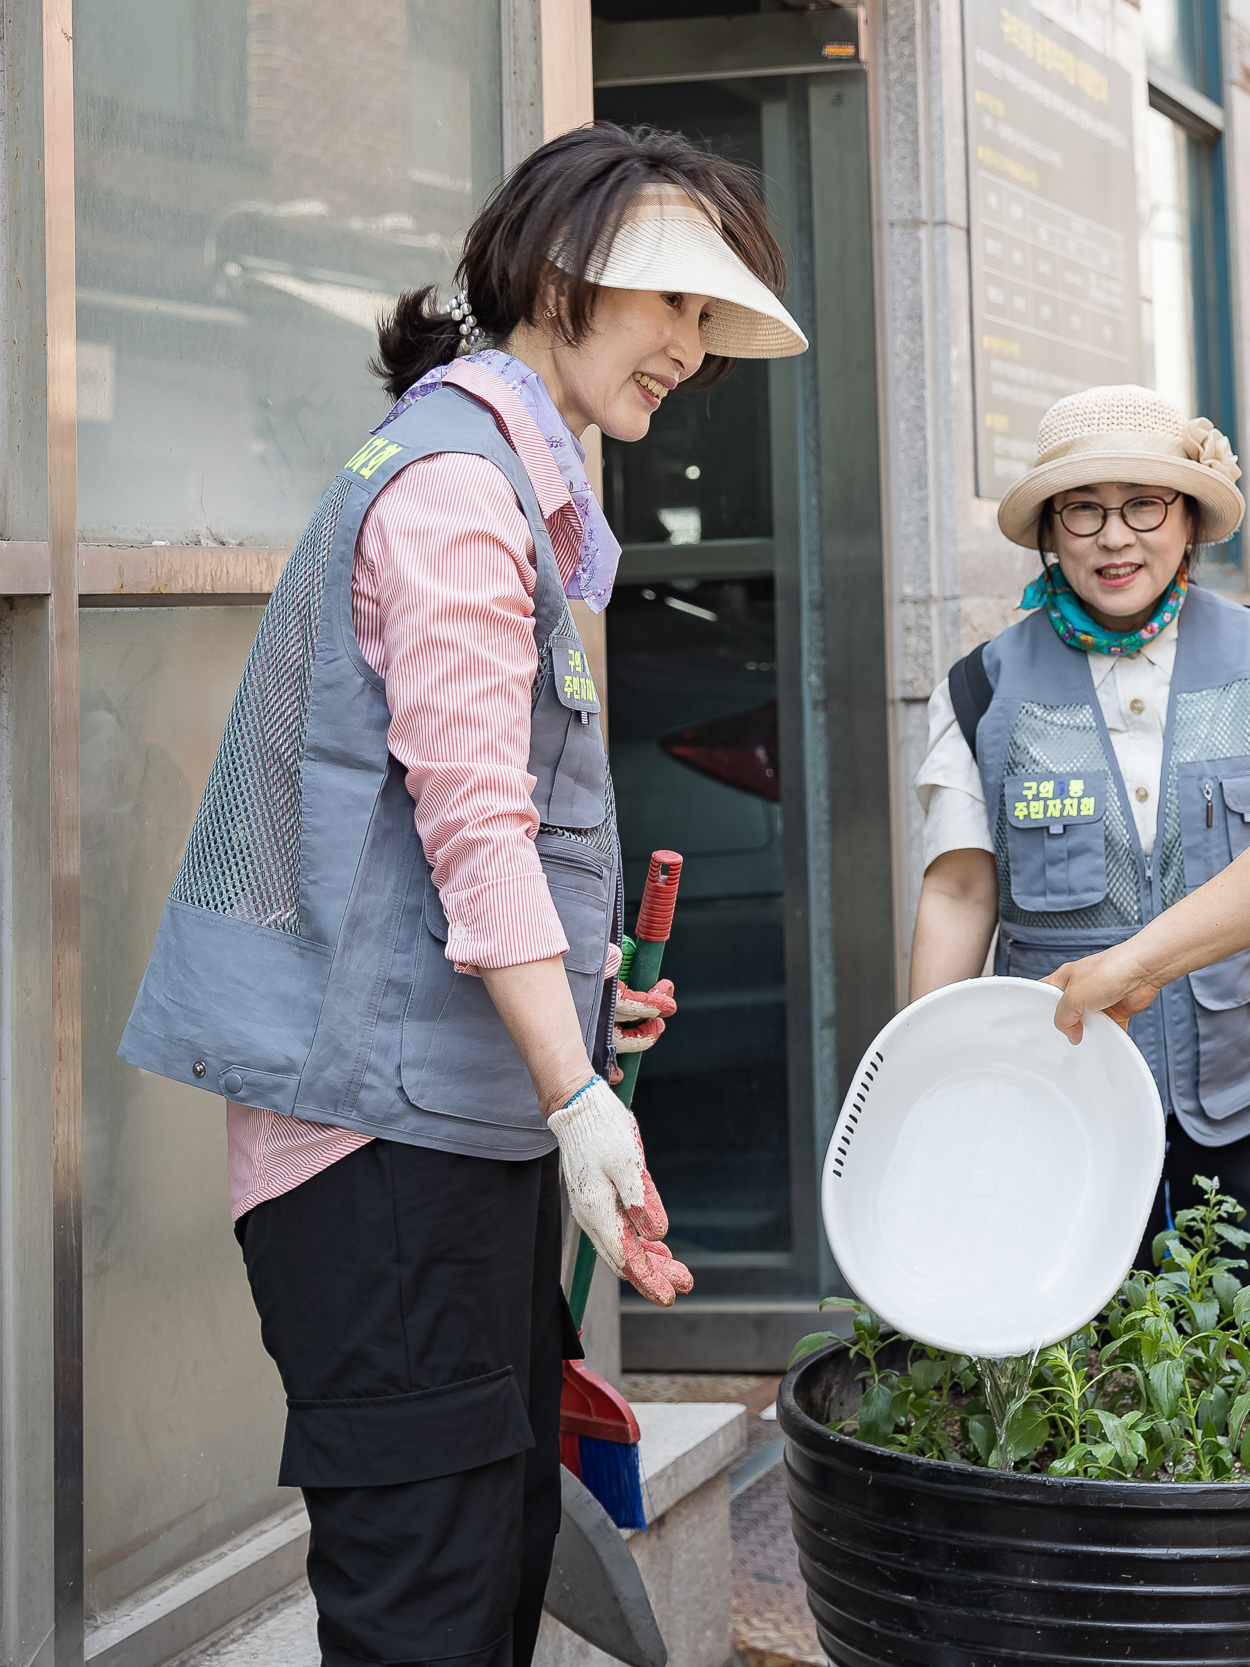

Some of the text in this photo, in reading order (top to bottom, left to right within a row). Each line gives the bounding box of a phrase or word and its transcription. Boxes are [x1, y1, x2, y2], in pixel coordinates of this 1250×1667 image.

[344, 435, 403, 480] 치회
[564, 675, 598, 702] 주민자치
[1014, 796, 1095, 821] 주민자치회
